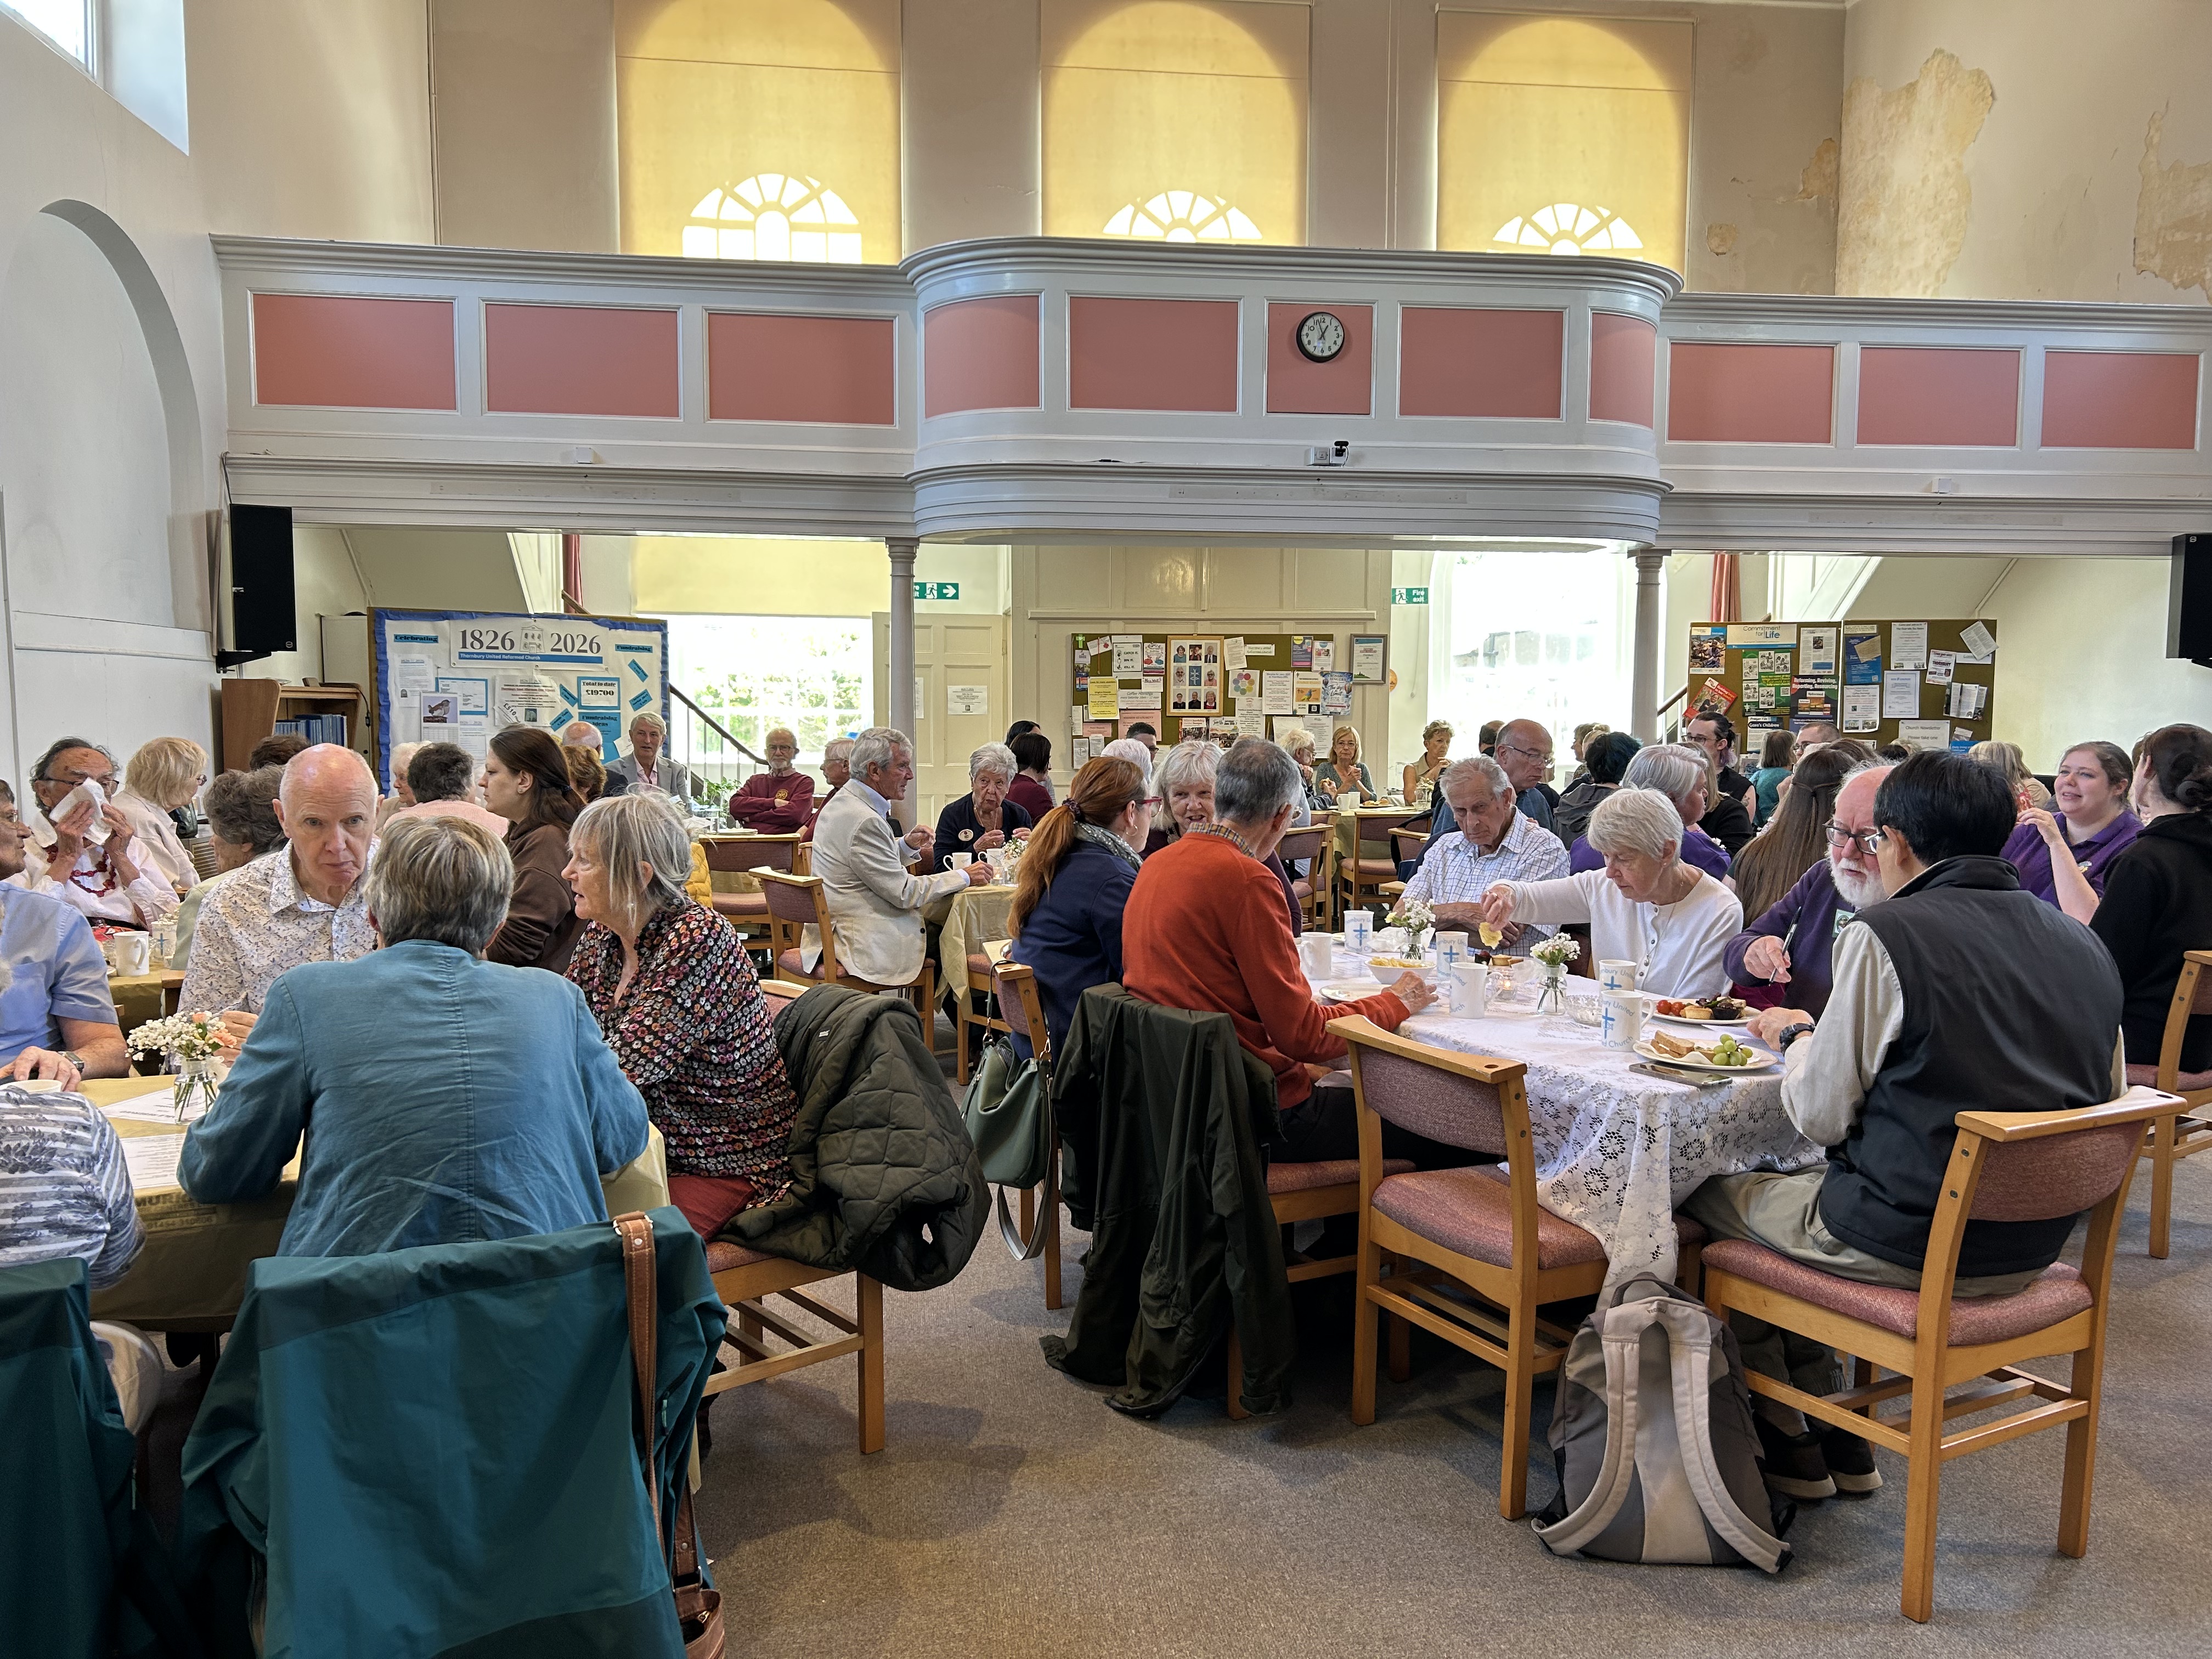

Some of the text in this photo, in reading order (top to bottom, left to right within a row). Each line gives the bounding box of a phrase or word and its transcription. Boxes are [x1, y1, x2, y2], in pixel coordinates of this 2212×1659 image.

[459, 629, 601, 653] 1826 2026
[1600, 967, 1617, 975] nbury
[1613, 1001, 1635, 1016] United
[1609, 1035, 1633, 1047] Church
